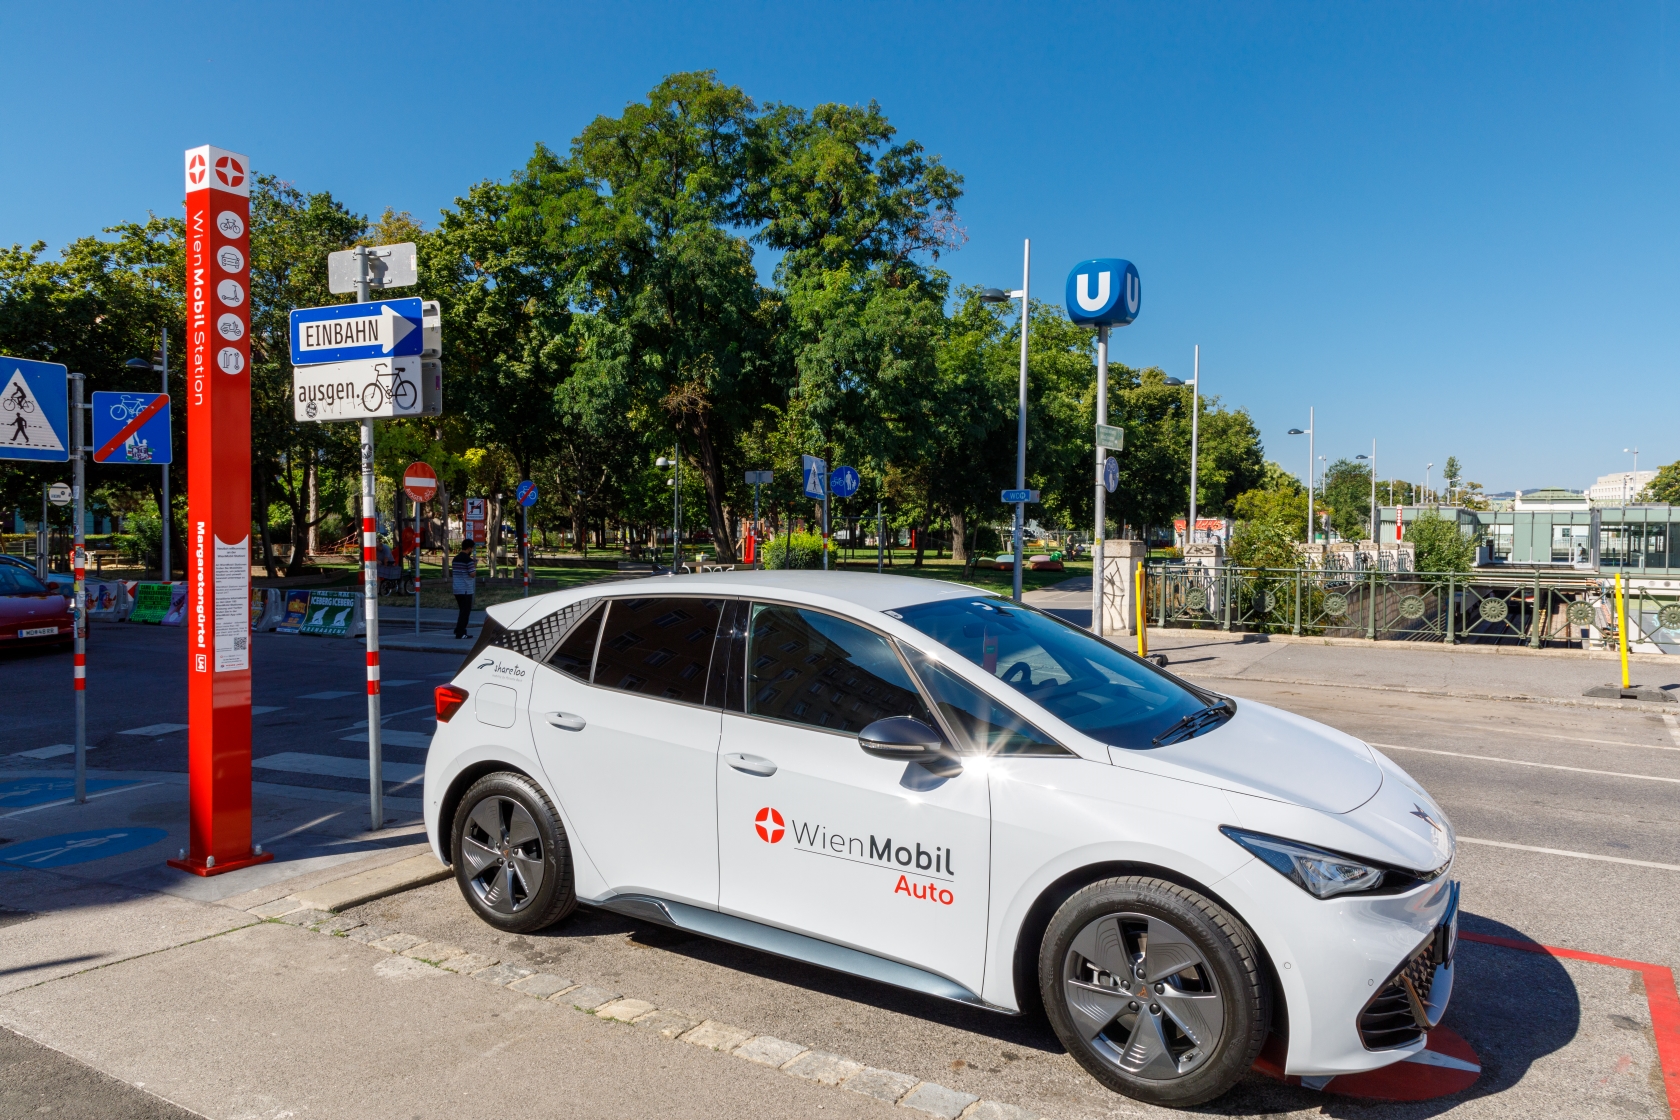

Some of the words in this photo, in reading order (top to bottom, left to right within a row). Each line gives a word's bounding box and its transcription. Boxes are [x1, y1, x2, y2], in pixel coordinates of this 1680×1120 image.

[193, 210, 205, 328] WienMobil
[1077, 271, 1110, 311] U
[1126, 272, 1139, 314] U
[306, 319, 379, 347] EINBAHN
[194, 331, 205, 405] Station
[298, 382, 360, 406] ausgen.
[196, 521, 206, 648] Margaretengürtel
[311, 596, 332, 606] ICEBERG
[332, 598, 354, 607] ICEBERG
[792, 820, 955, 876] WienMobil
[894, 875, 954, 905] Auto
